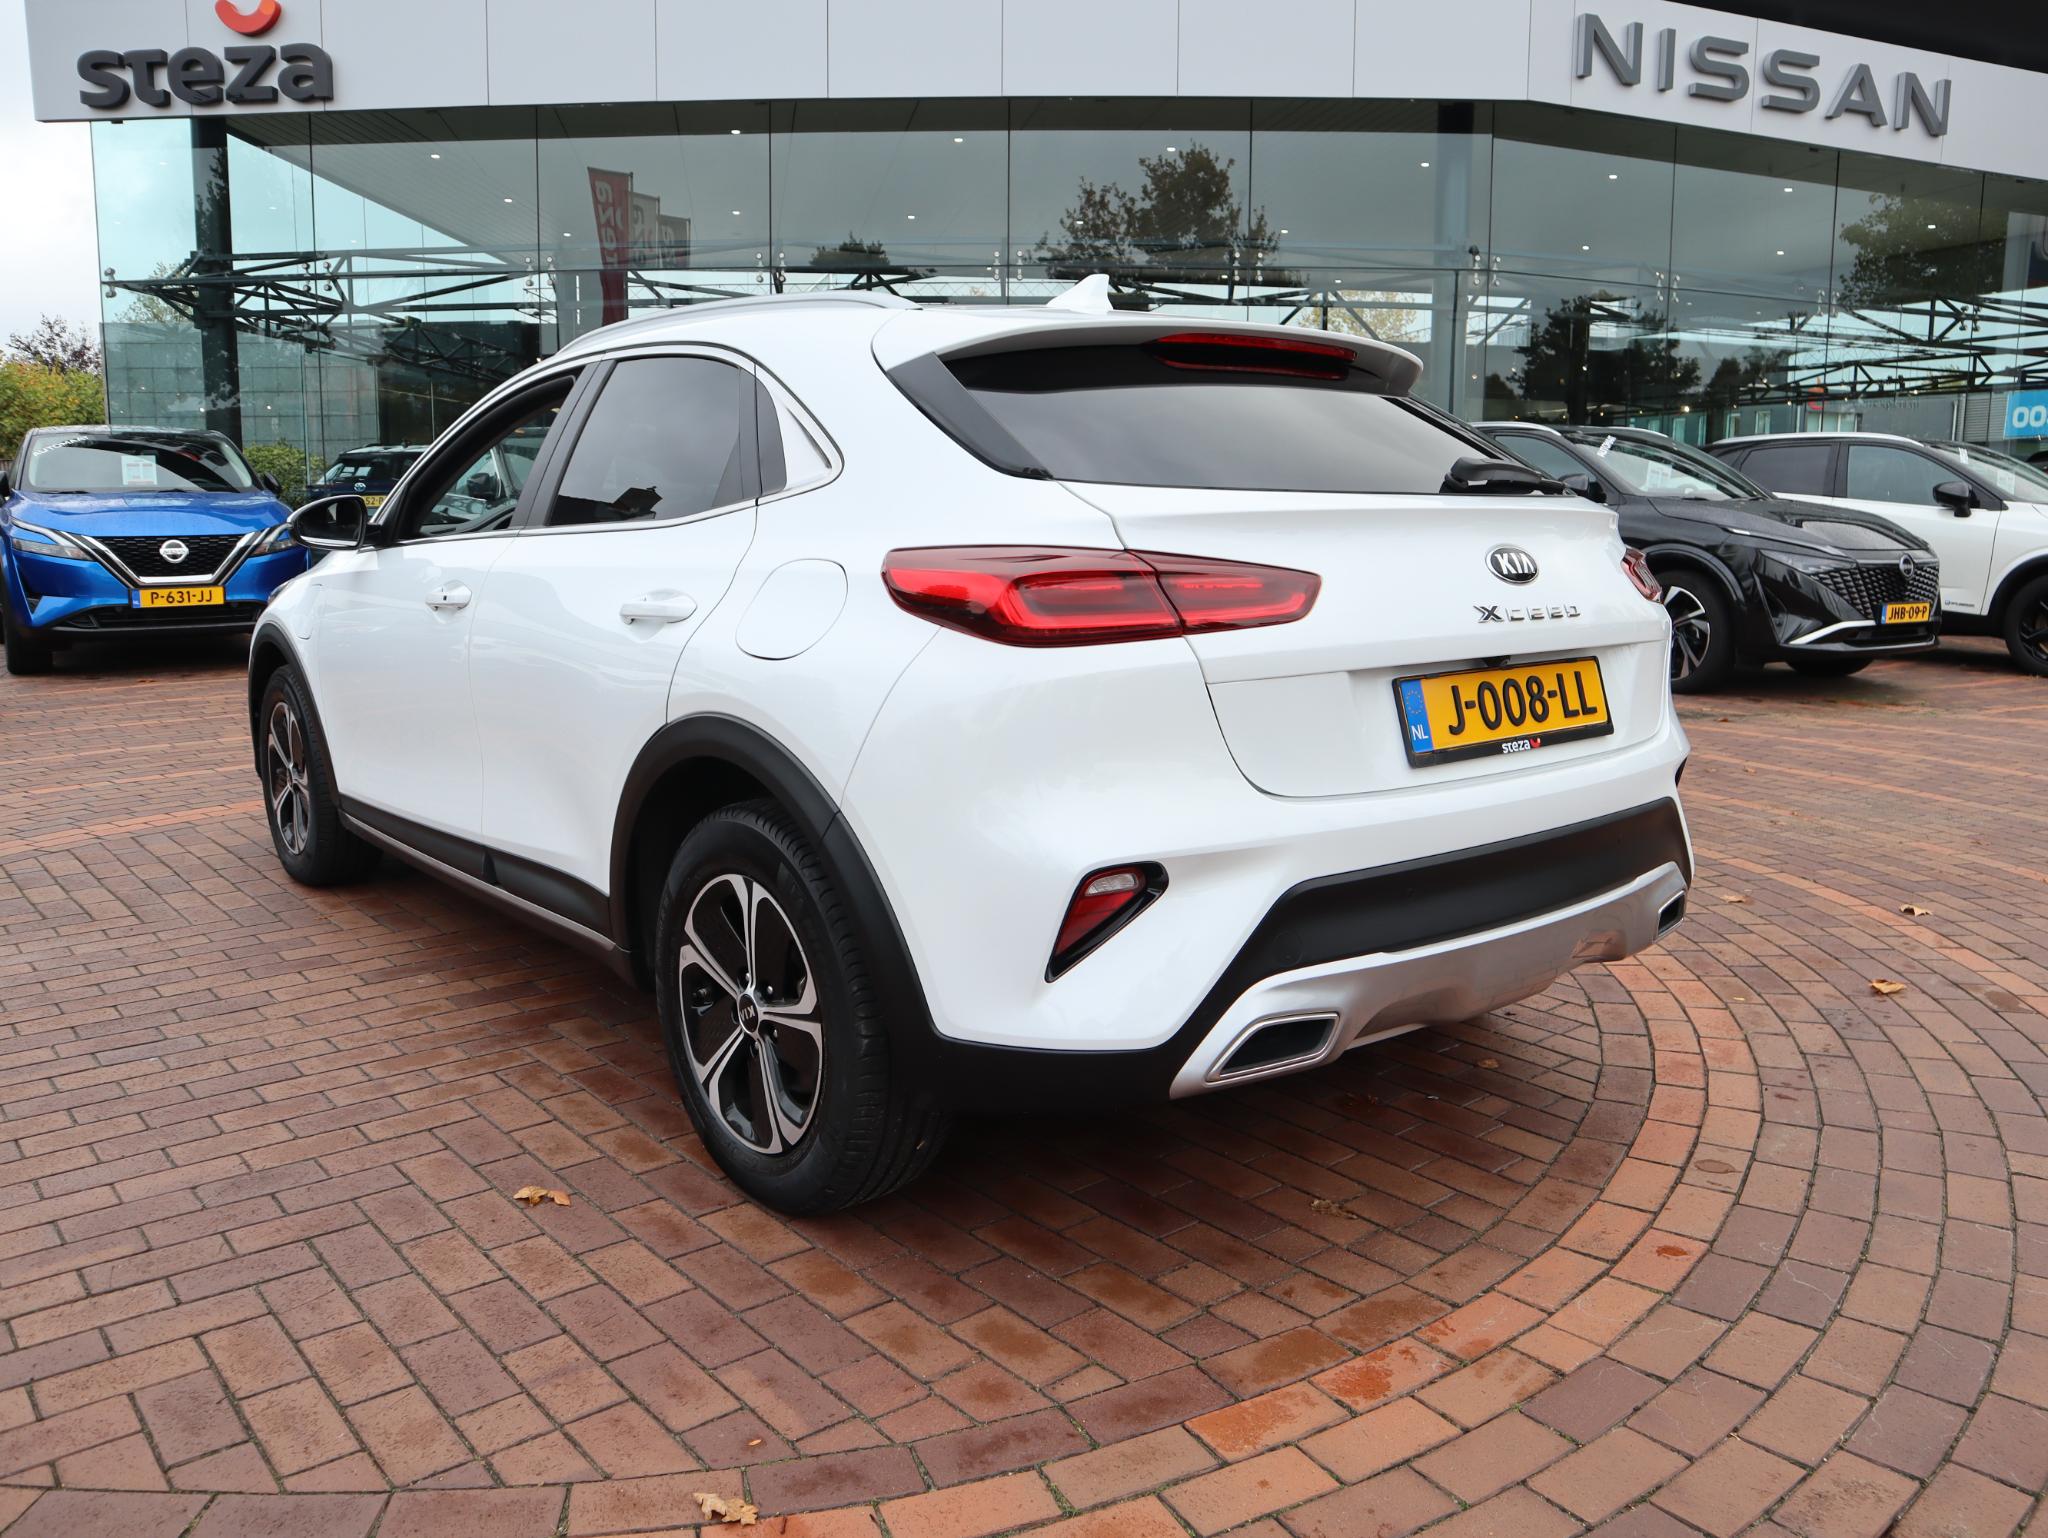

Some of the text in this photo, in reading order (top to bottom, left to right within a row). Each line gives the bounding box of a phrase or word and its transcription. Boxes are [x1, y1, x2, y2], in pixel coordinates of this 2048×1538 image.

[77, 43, 334, 108] steza
[1576, 13, 1952, 138] NISSAN
[1495, 552, 1537, 575] KIA
[150, 590, 213, 605] P-631-JJ
[1473, 604, 1581, 624] XCEED
[1888, 605, 1928, 620] JHB-09-P
[1448, 670, 1598, 736] J-008-LL
[1411, 723, 1429, 741] NL
[1501, 739, 1531, 754] steza
[739, 1005, 756, 1022] KIA
